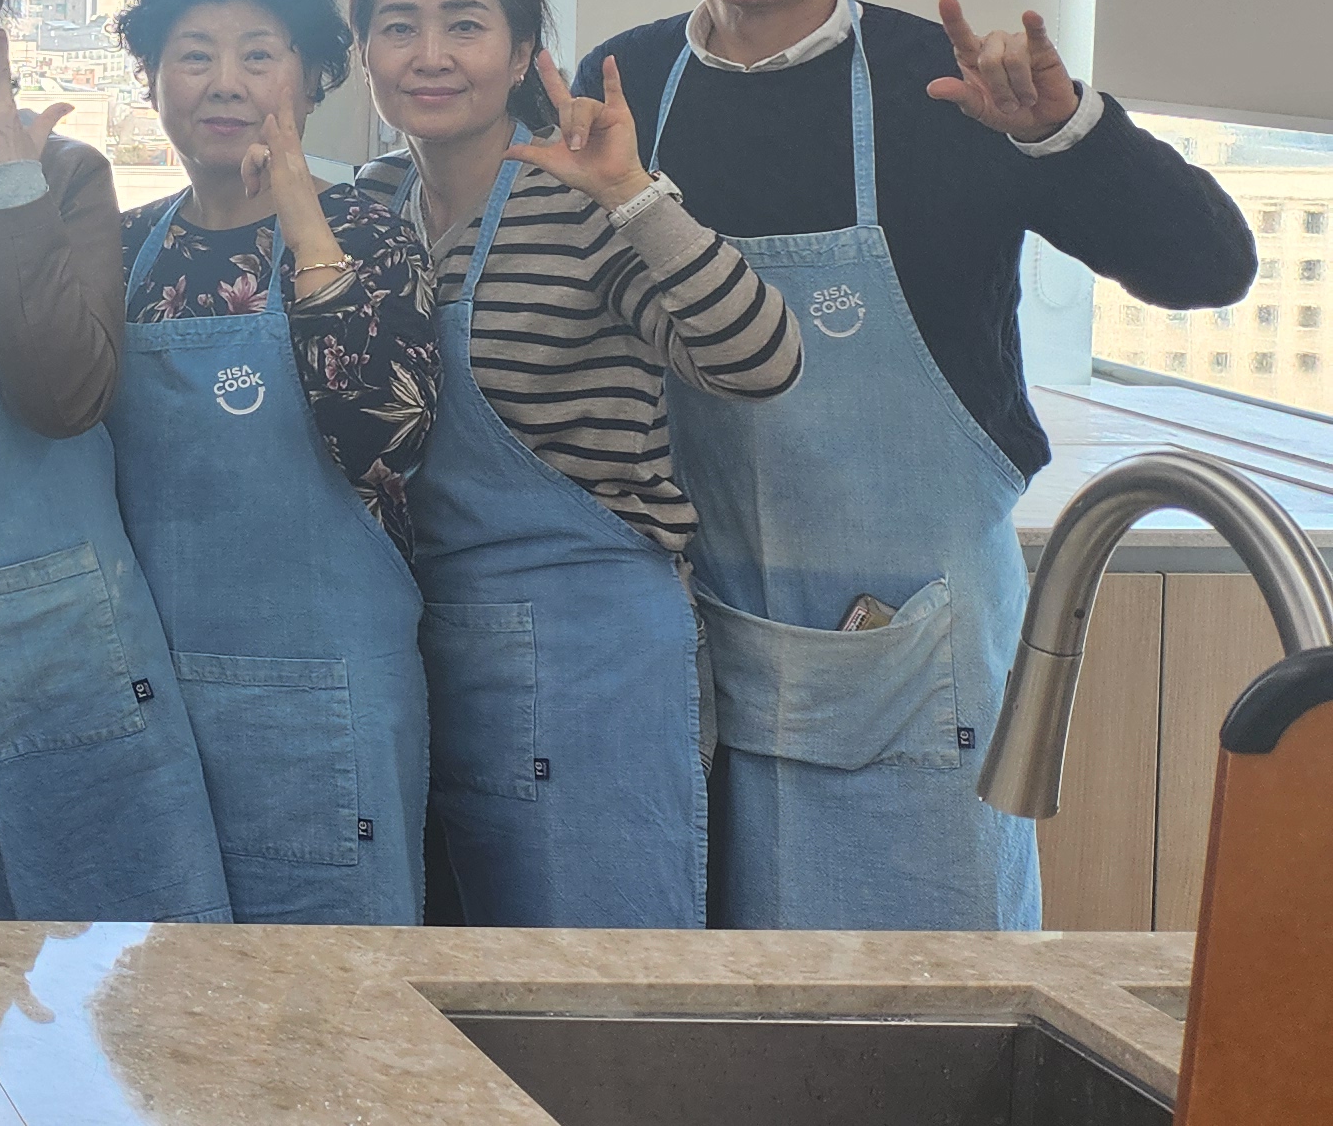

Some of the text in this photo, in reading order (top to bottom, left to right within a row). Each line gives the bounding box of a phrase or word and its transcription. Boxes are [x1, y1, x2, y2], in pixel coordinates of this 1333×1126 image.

[813, 284, 852, 302] SISA
[810, 292, 863, 316] COOK
[217, 365, 253, 381] SISA
[213, 372, 264, 395] COOK
